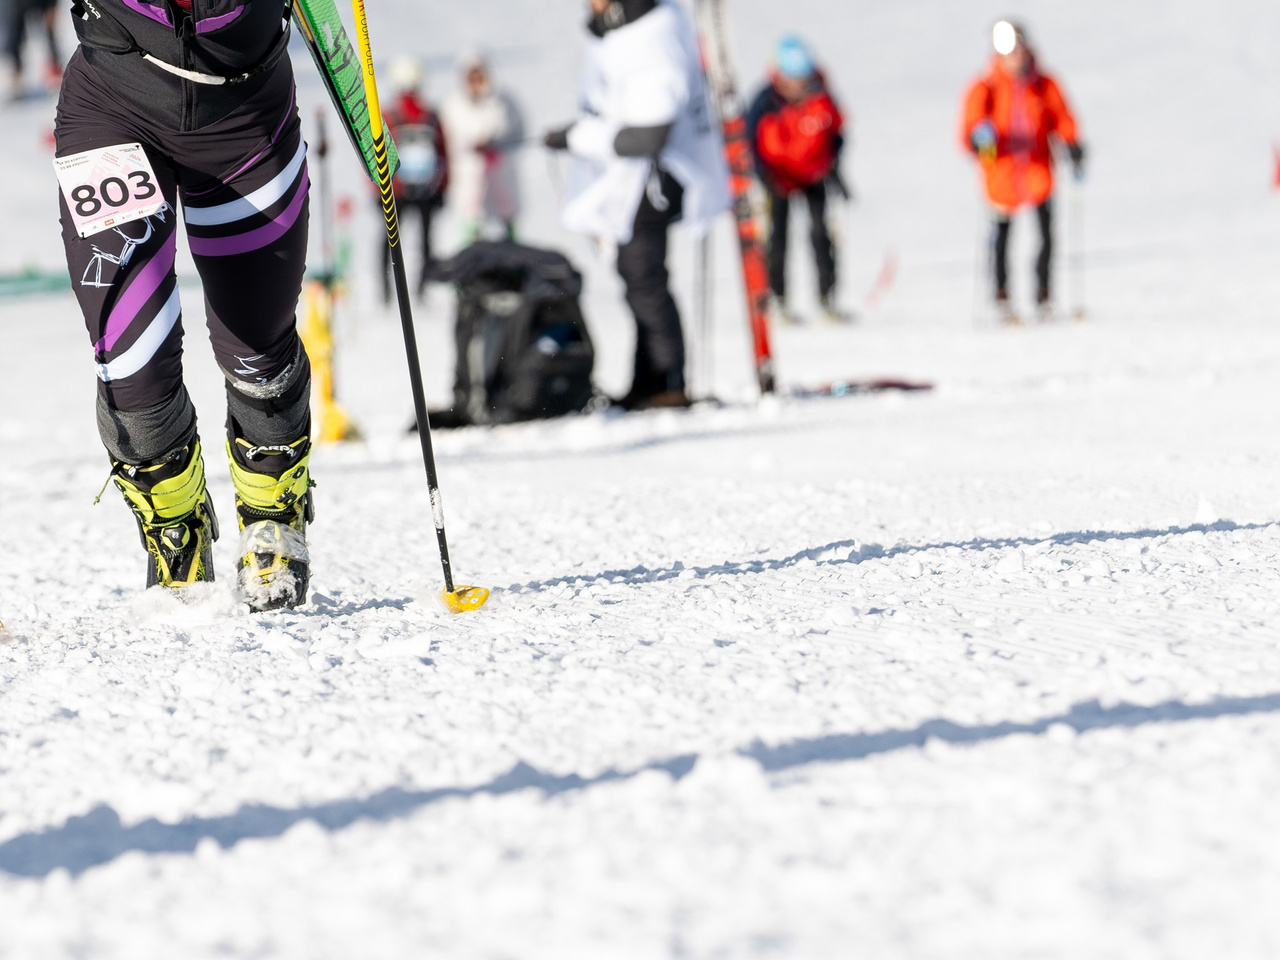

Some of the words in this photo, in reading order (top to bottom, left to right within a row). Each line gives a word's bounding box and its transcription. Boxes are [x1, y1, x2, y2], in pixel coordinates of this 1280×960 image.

[324, 26, 354, 75] 65
[71, 170, 157, 217] 803
[245, 445, 295, 460] SCARPA
